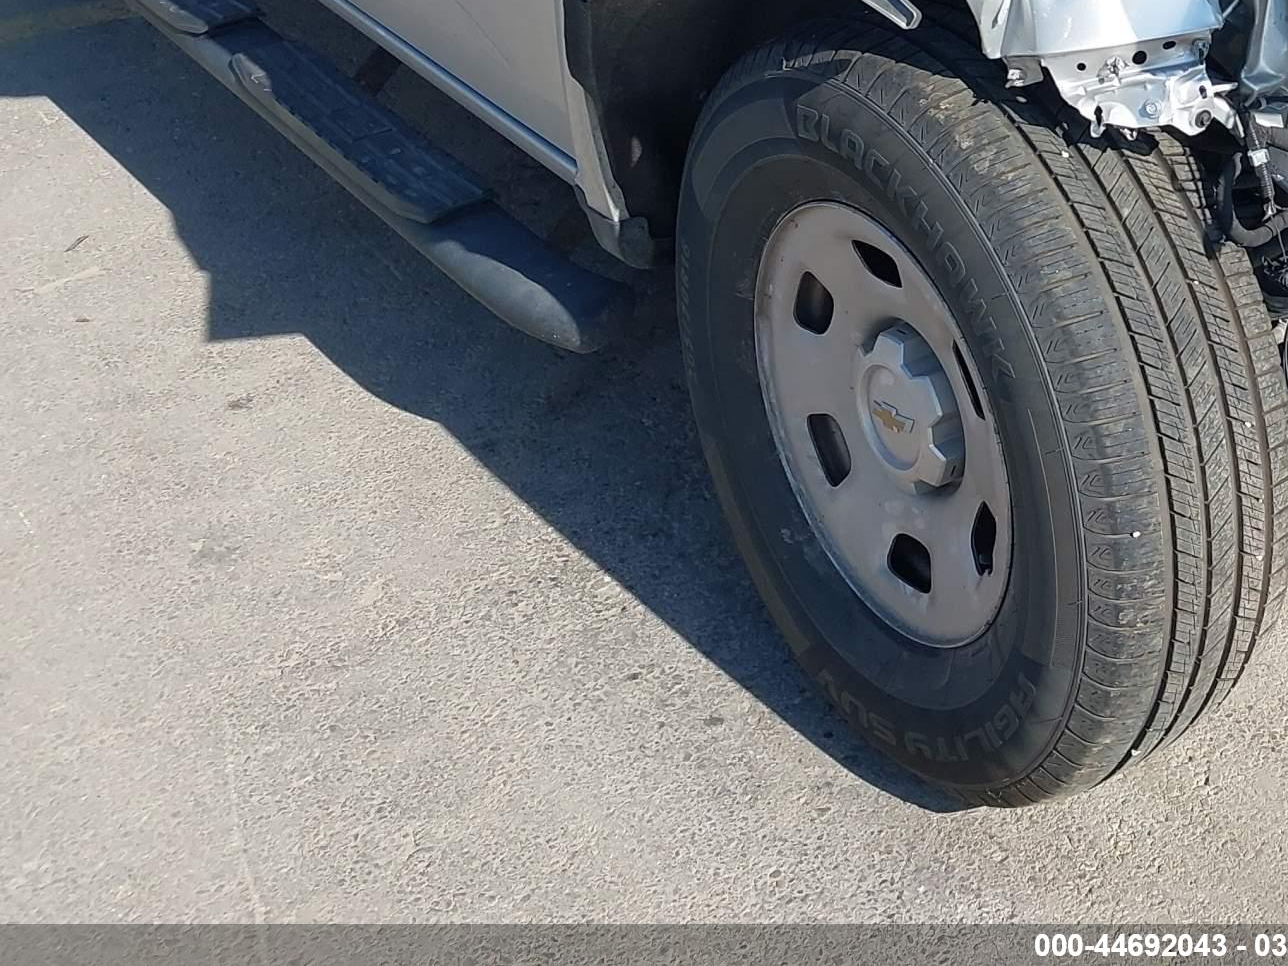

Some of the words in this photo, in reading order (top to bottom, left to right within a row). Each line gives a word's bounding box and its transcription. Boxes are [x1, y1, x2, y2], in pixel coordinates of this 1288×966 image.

[796, 102, 1016, 381] BLACKHAWK
[815, 667, 897, 747] SUV
[903, 671, 1037, 762] AGILITY
